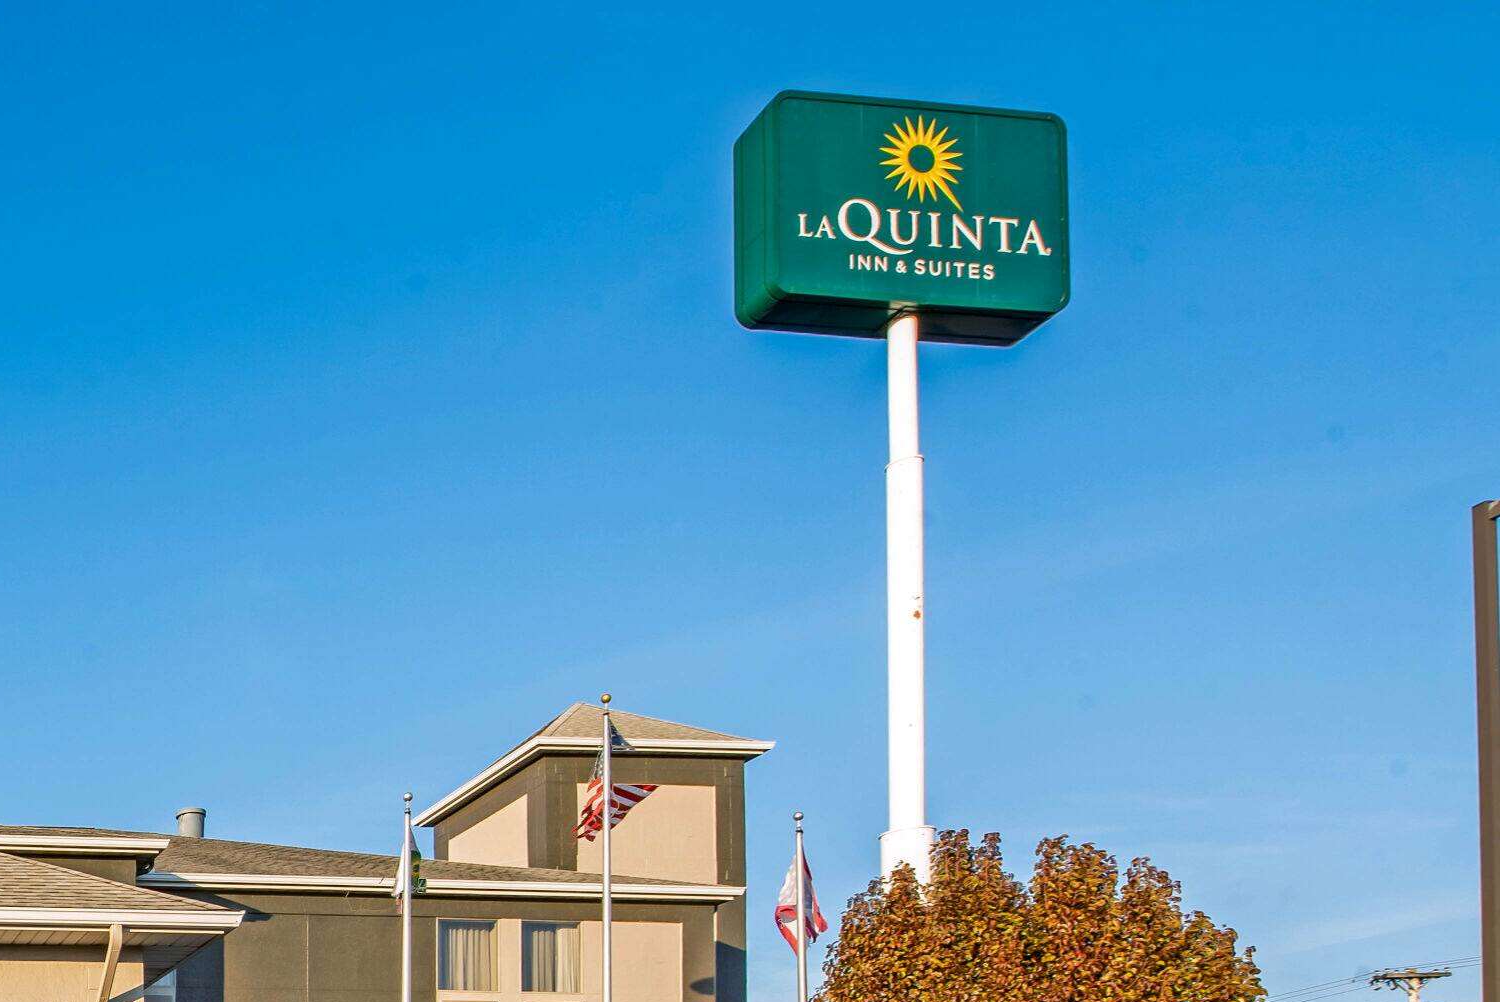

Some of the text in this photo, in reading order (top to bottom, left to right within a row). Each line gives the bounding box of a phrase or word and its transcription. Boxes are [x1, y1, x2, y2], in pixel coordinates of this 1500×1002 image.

[798, 198, 1052, 256] LA QUINTA
[849, 254, 996, 280] INN & SUITES
